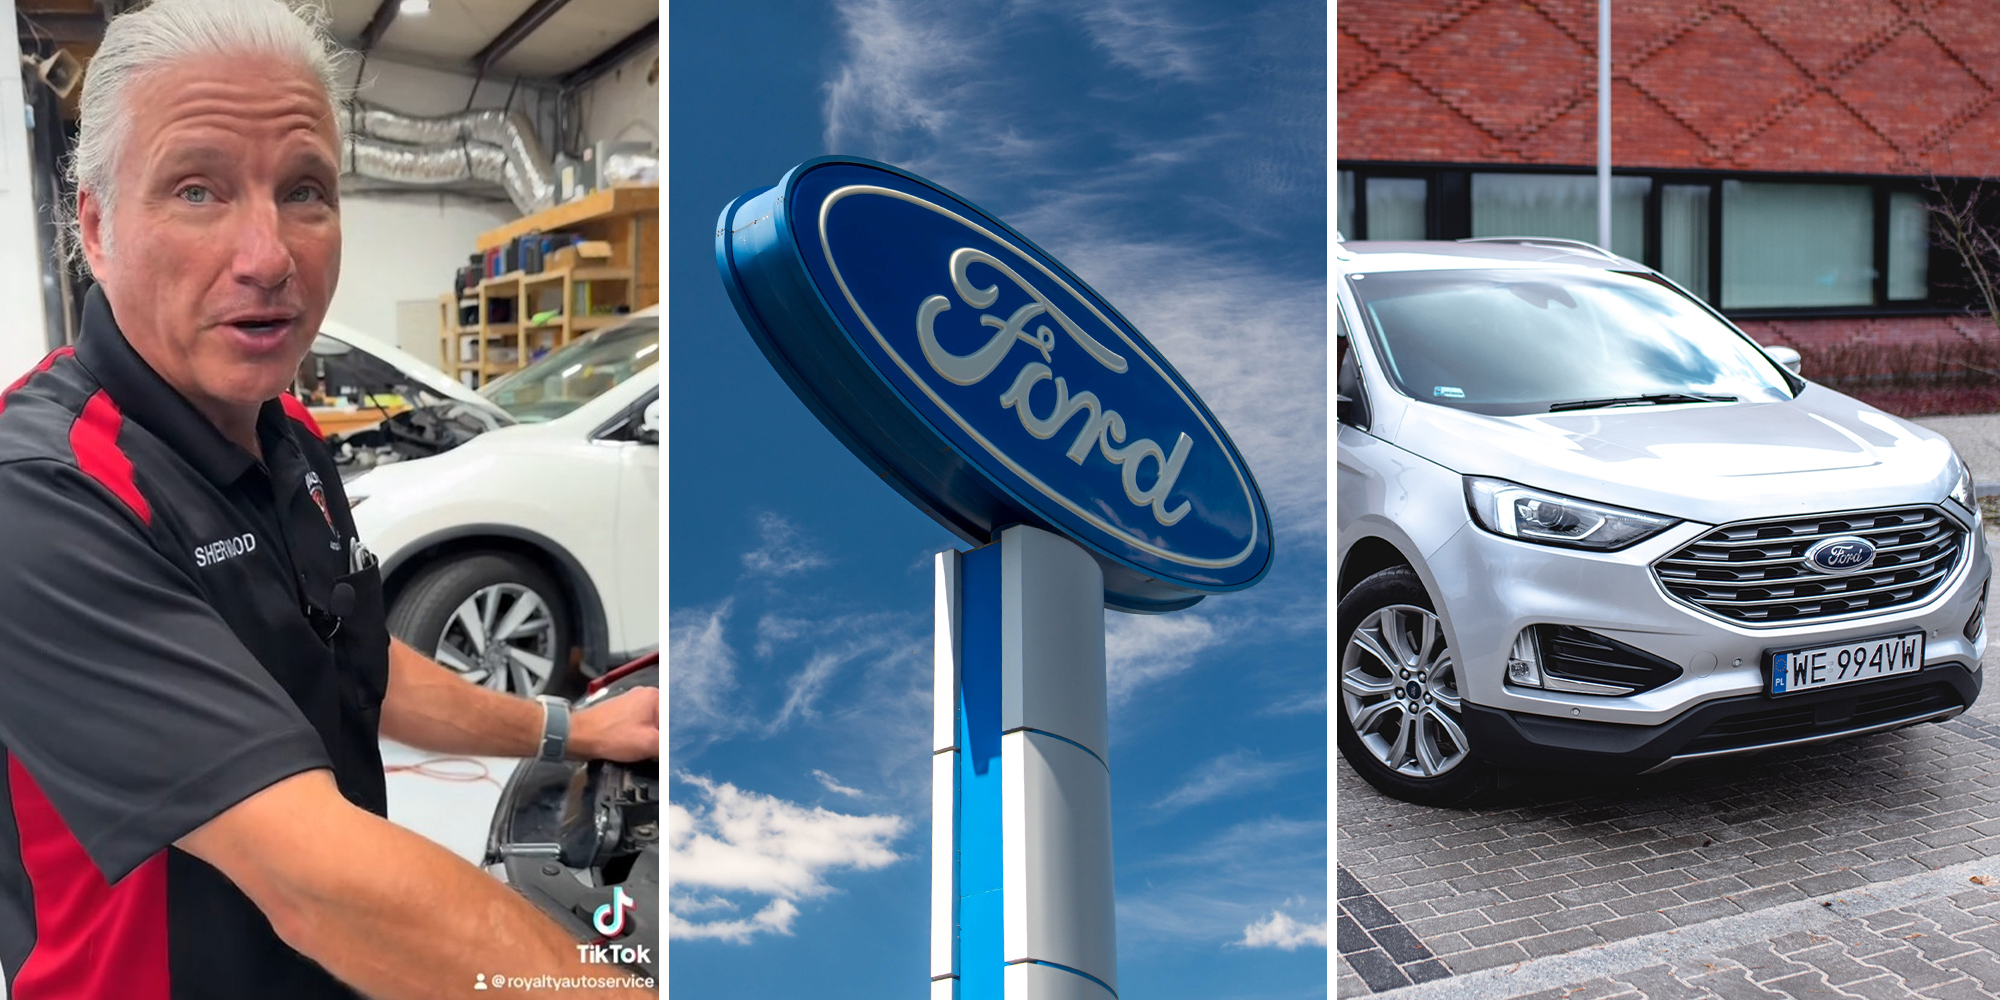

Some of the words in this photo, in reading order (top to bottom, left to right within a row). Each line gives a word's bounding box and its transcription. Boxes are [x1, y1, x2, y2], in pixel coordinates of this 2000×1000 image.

[916, 247, 1194, 527] Ford
[1828, 545, 1863, 566] Ford
[1793, 653, 1827, 687] WE
[1838, 639, 1915, 680] 994VW
[1775, 678, 1785, 687] PL
